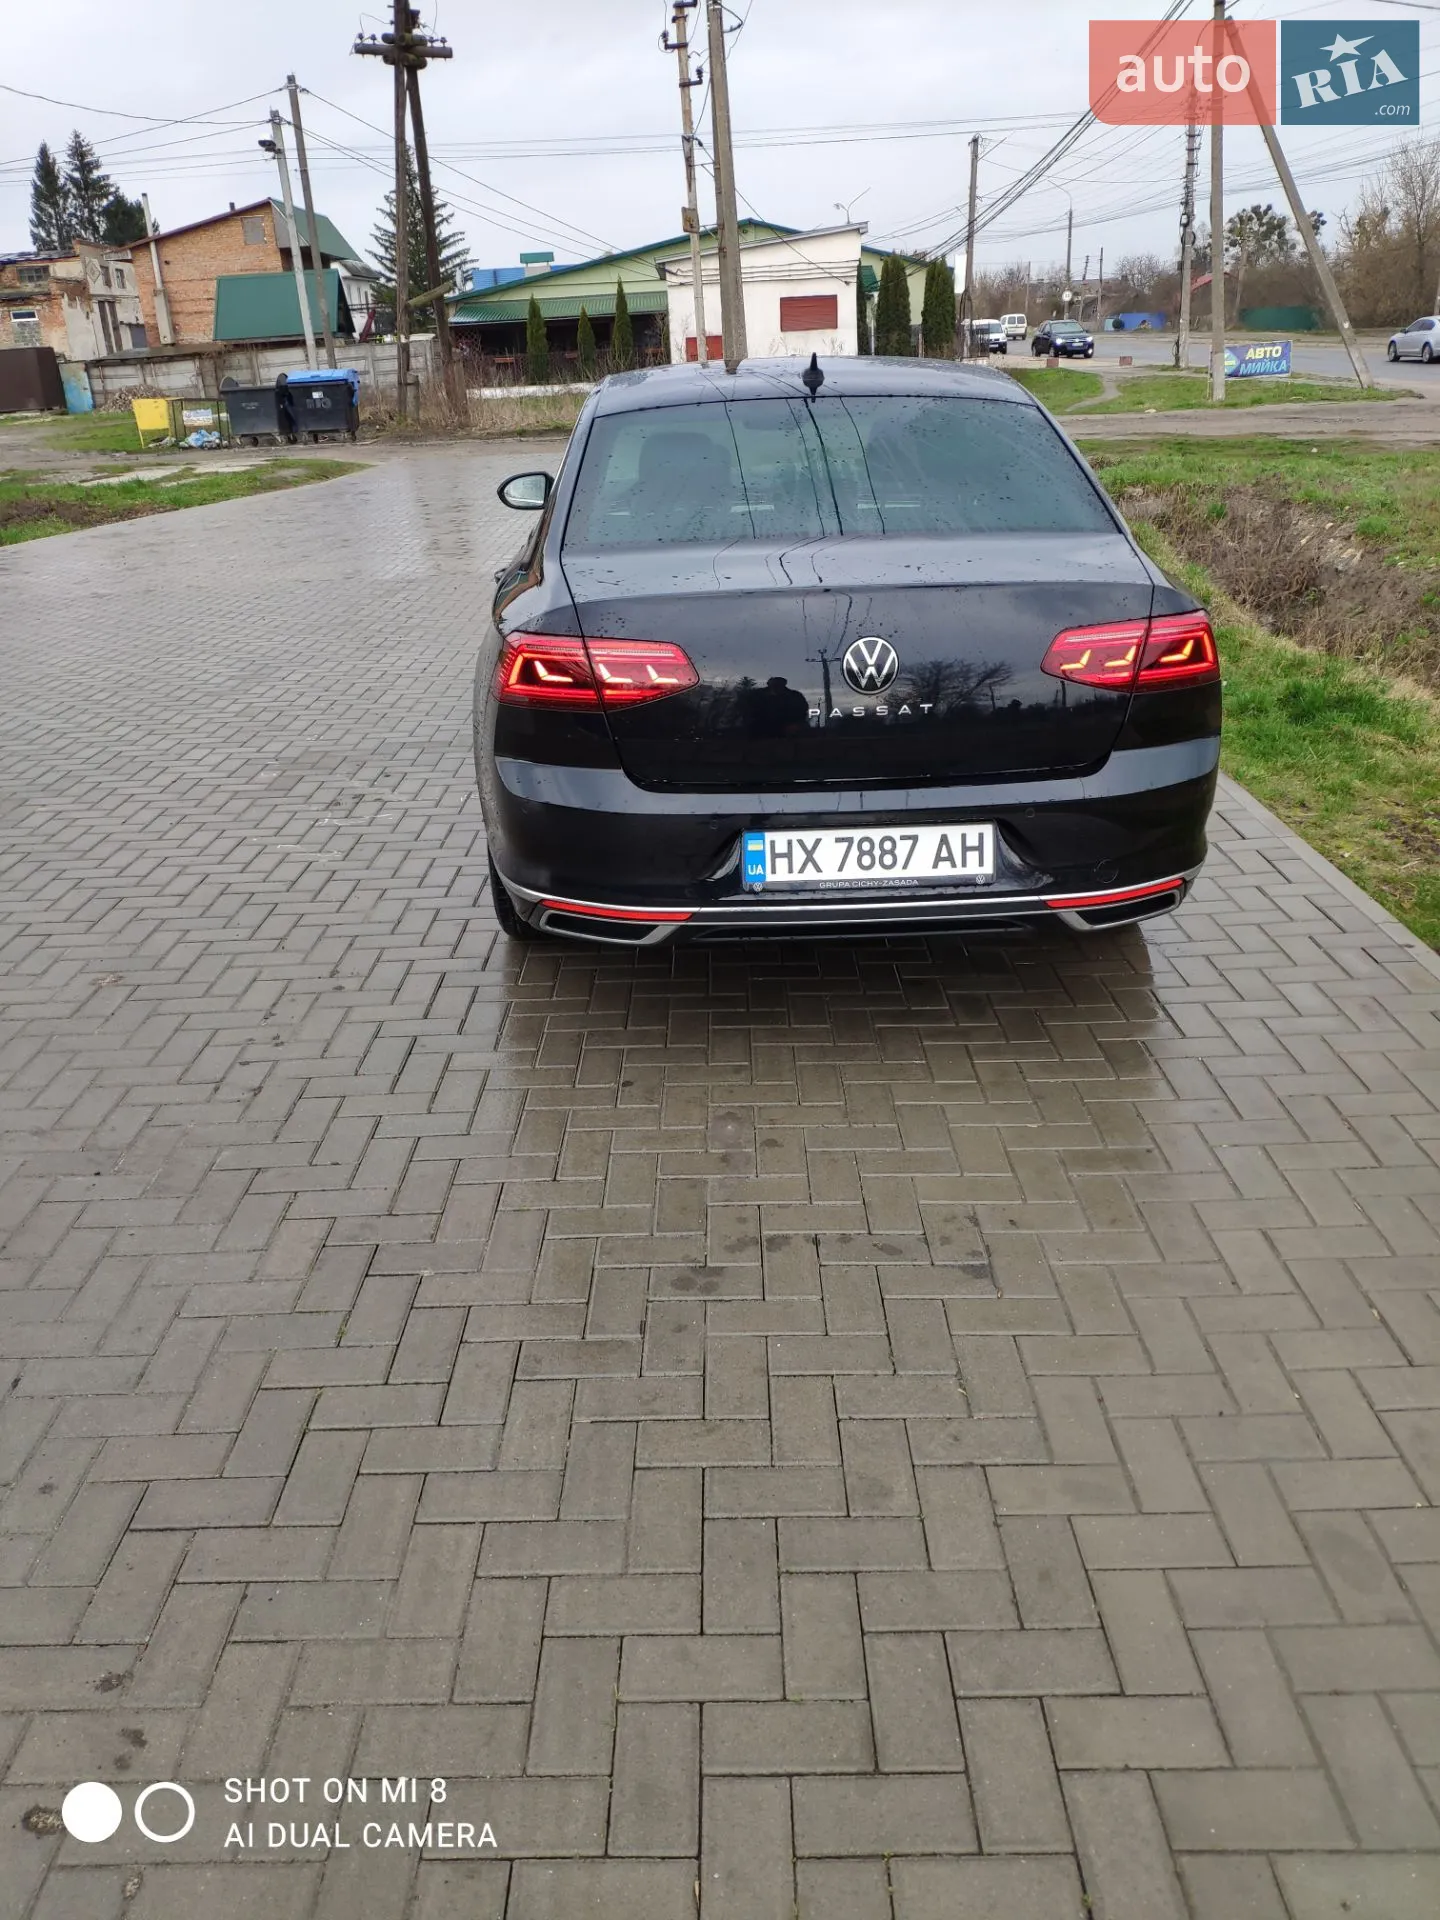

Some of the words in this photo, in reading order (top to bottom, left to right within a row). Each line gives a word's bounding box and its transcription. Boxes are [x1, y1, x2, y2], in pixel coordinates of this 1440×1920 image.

[1245, 345, 1282, 360] АВТО
[1239, 359, 1287, 376] МИЙКА
[808, 703, 933, 719] PASSAT
[769, 838, 823, 875] HX
[834, 834, 919, 872] 7887
[931, 832, 985, 870] AH
[748, 864, 764, 876] UA
[819, 881, 850, 889] GRUPA
[852, 879, 919, 888] CICHY-ZASADA
